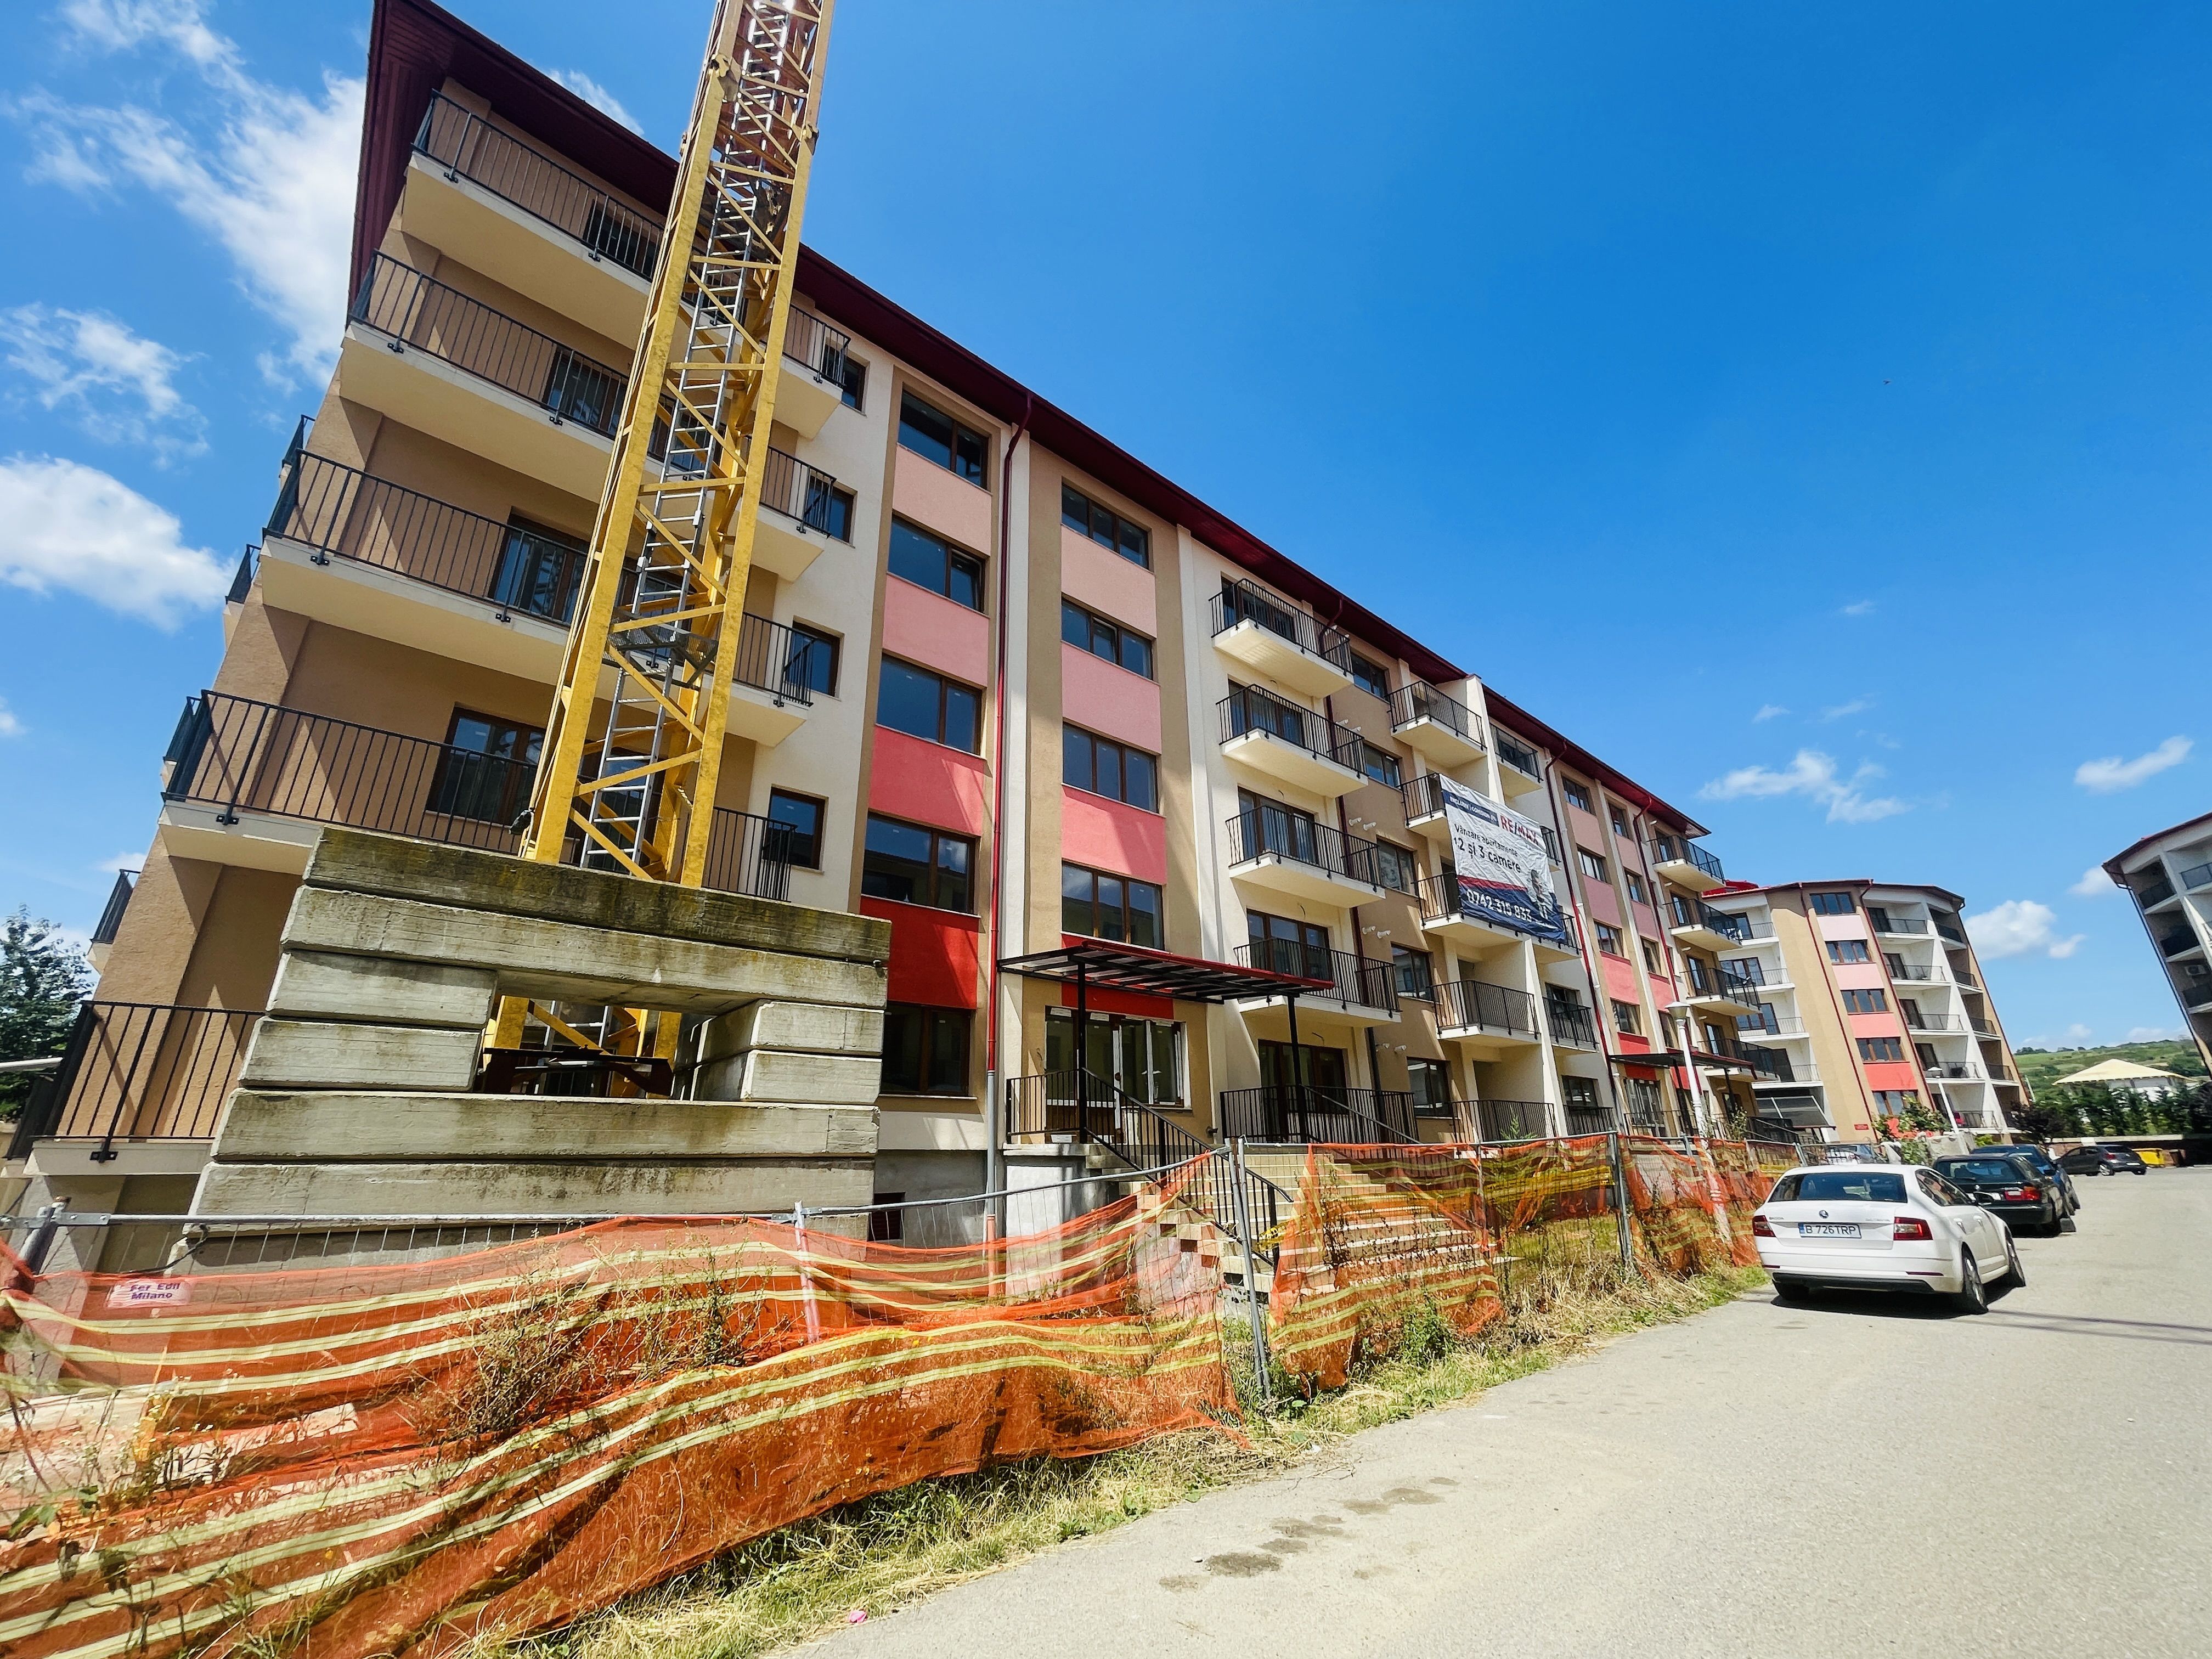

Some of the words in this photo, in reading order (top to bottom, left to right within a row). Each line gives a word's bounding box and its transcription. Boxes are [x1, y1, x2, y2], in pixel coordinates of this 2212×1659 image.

[1454, 823, 1481, 841] Vânzare
[1500, 815, 1539, 845] RE/MAX
[1478, 845, 1485, 859] 3
[1488, 851, 1521, 873] camere
[1466, 888, 1494, 911] 0742
[1514, 905, 1532, 923] 833
[1805, 1225, 1813, 1234] B
